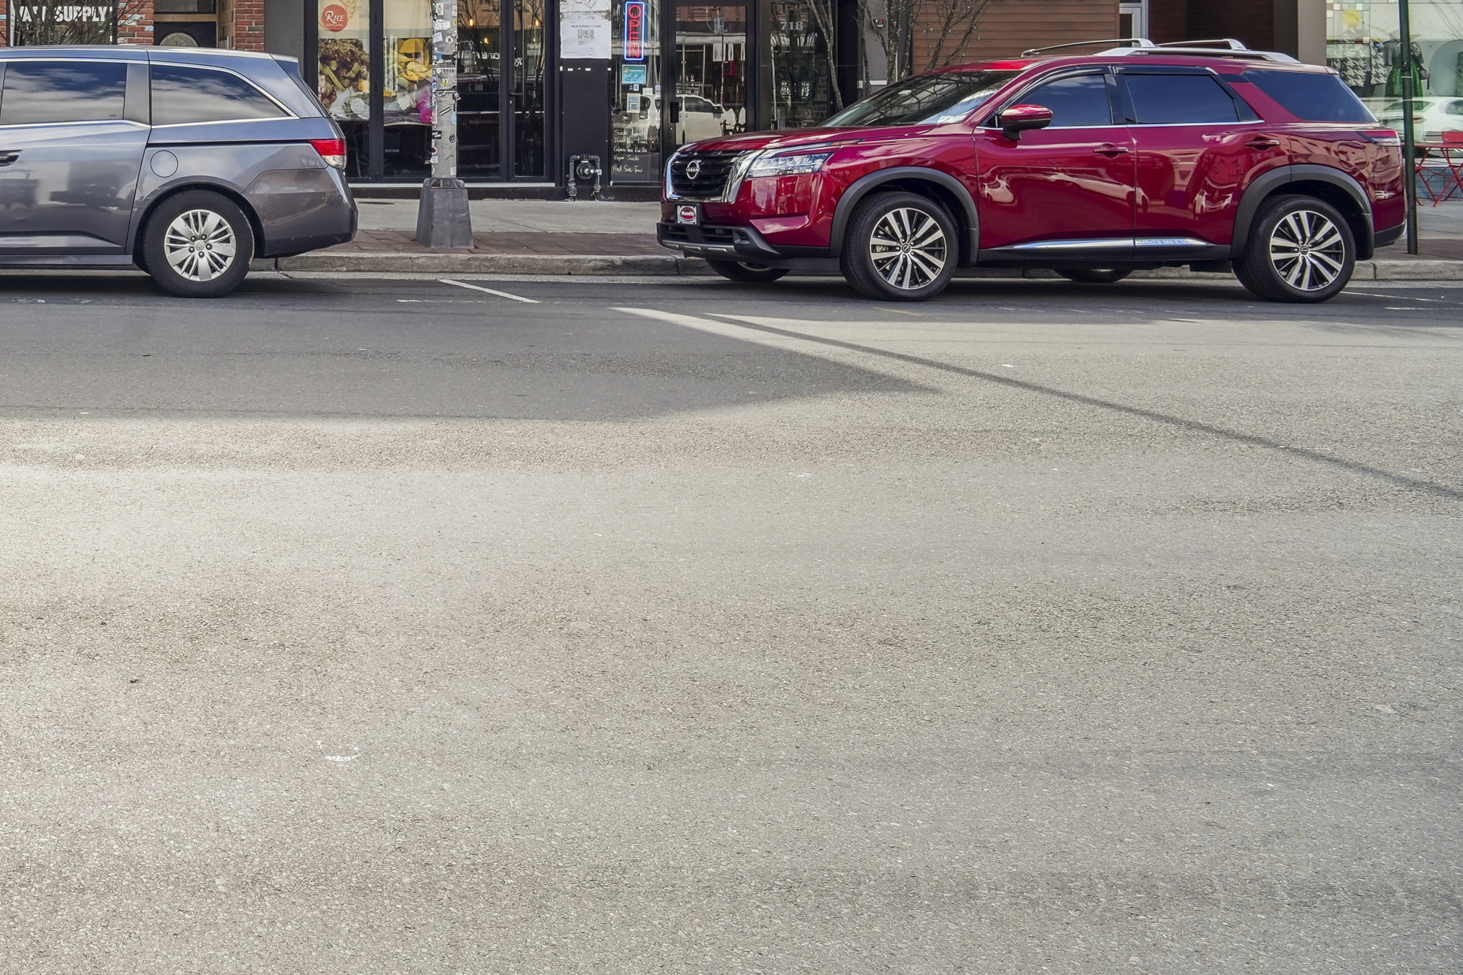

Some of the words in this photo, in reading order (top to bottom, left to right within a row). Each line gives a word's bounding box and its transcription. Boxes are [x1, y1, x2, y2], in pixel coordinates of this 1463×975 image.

[54, 6, 108, 22] SUPPLY
[628, 5, 642, 58] OPEN
[780, 21, 804, 31] 718
